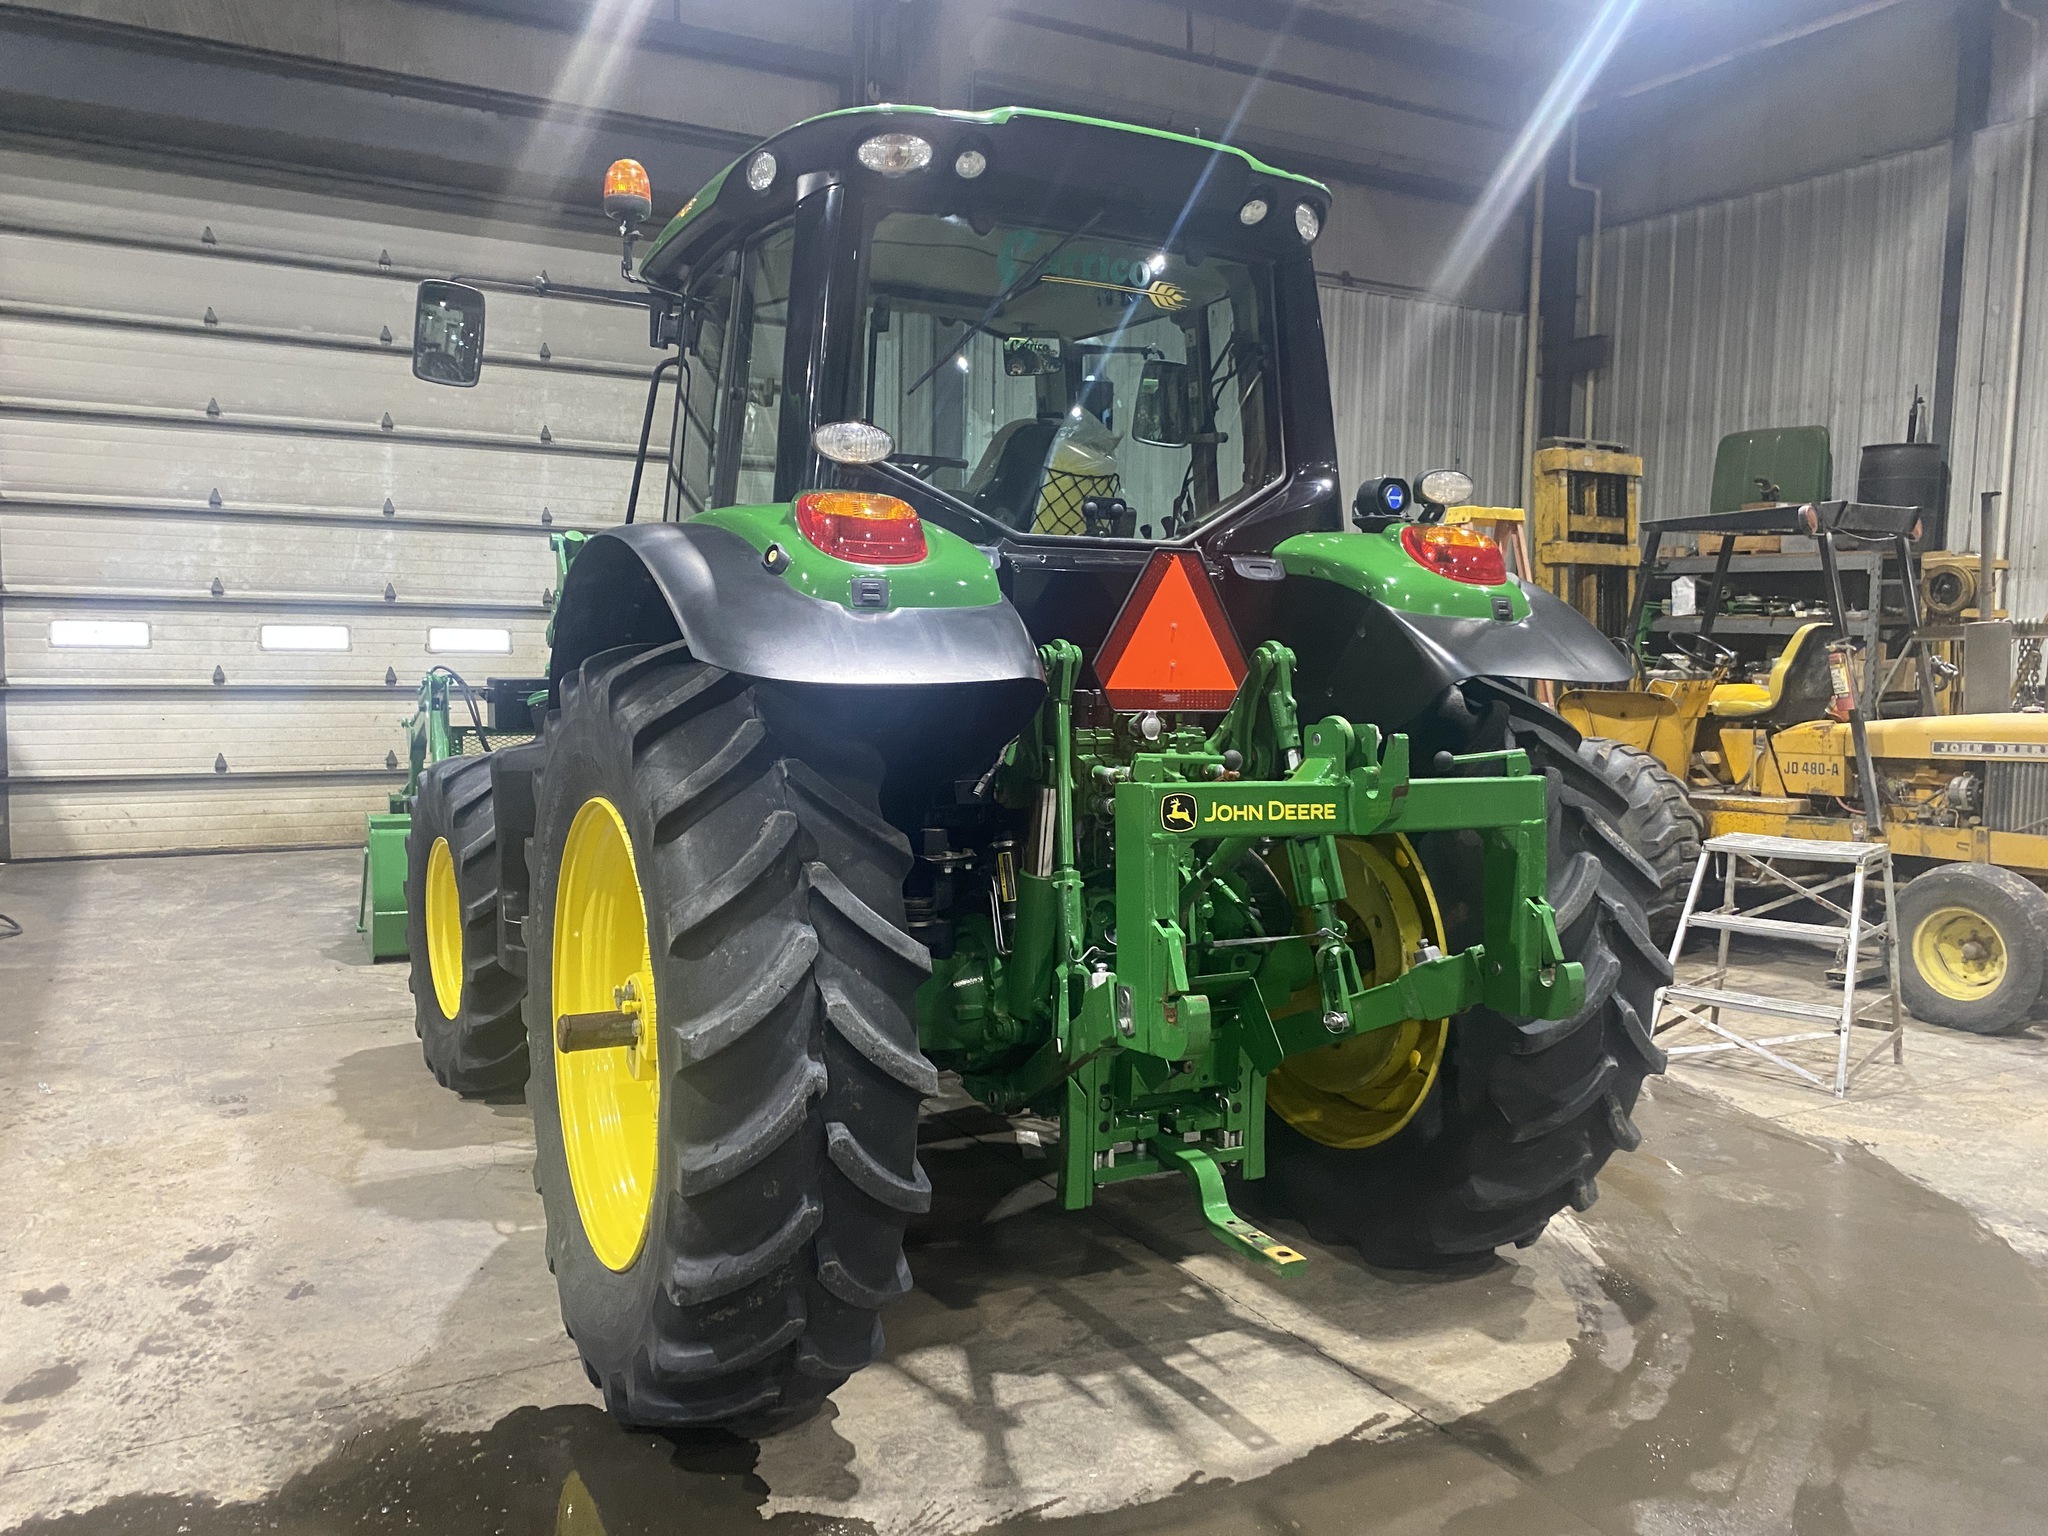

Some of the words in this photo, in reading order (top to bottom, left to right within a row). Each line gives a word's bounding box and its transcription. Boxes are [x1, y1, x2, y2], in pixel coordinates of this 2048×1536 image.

[1010, 339, 1049, 353] Crrico
[1940, 743, 1983, 753] JOHN
[1994, 744, 2048, 755] DEER
[1784, 761, 1799, 774] JD
[1802, 762, 1839, 776] 480-A
[1204, 801, 1263, 823] JOHN
[1268, 800, 1336, 821] DEERE
